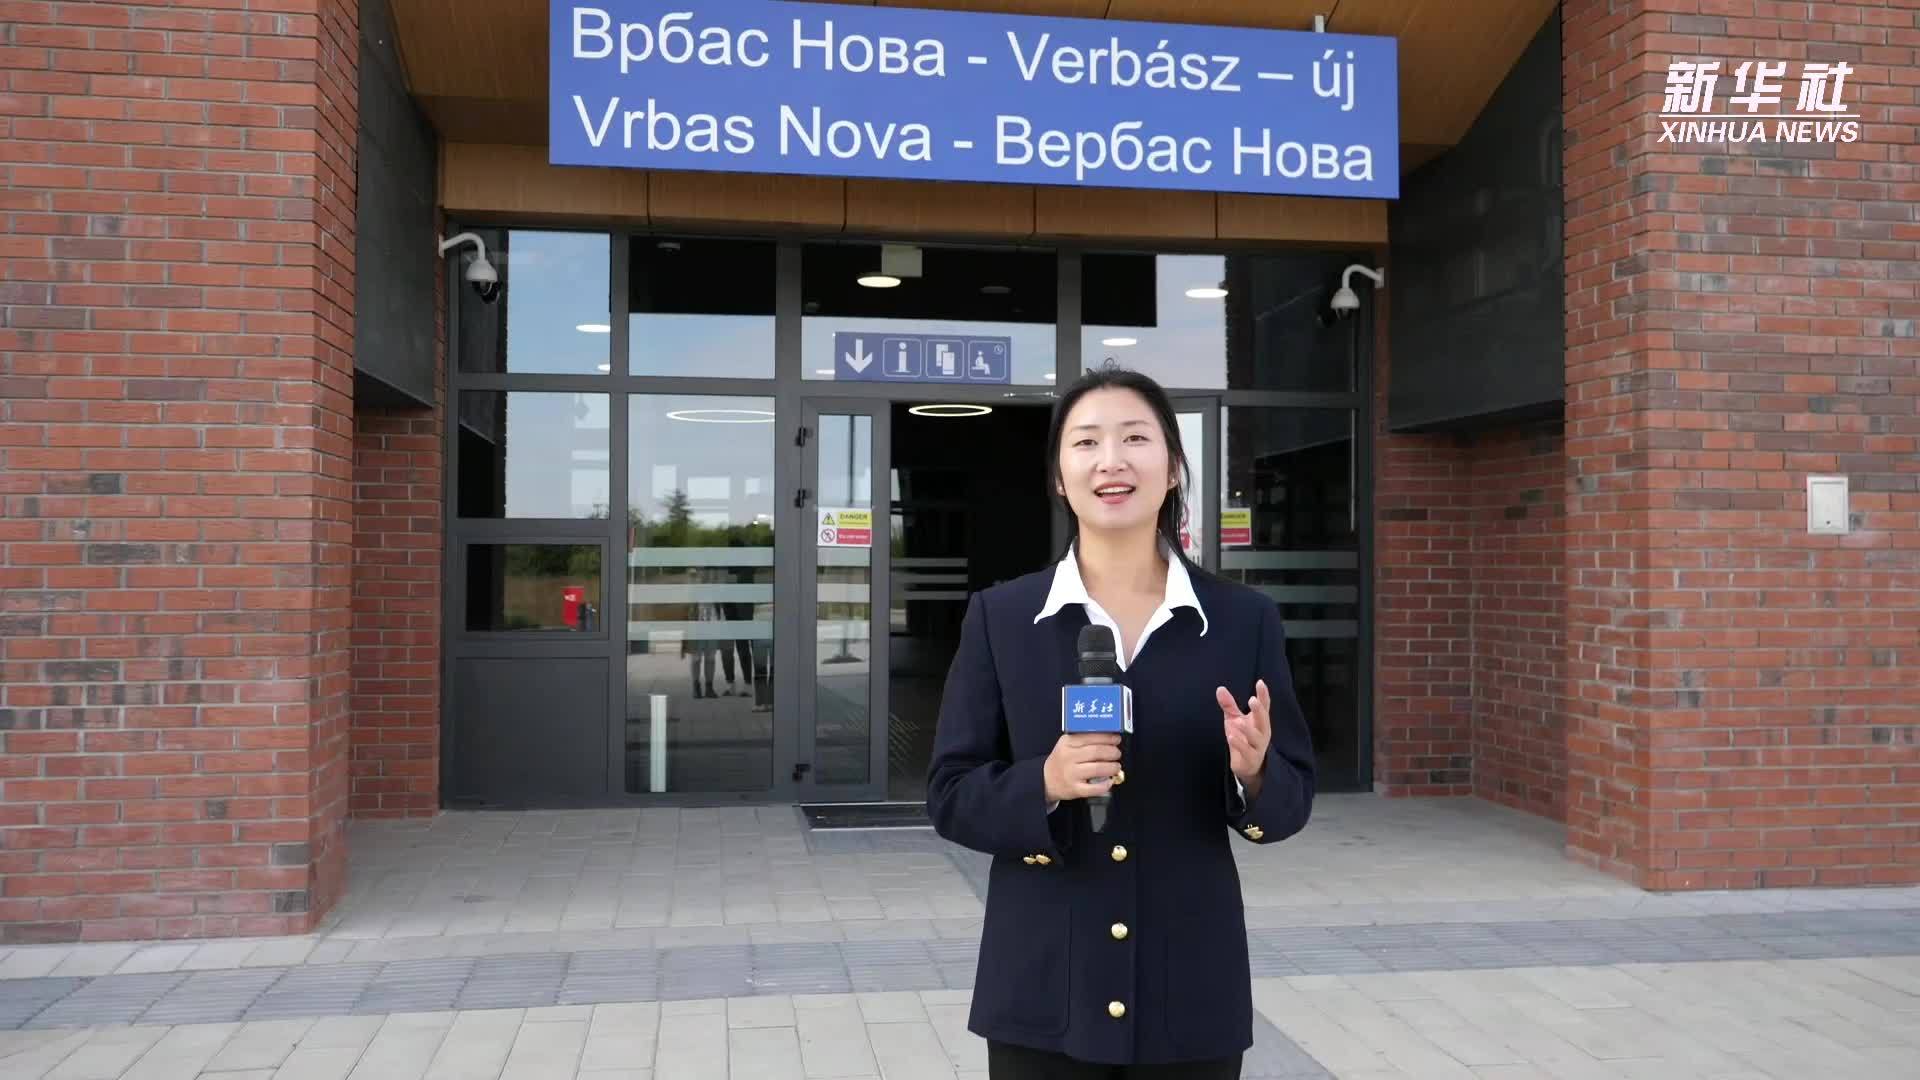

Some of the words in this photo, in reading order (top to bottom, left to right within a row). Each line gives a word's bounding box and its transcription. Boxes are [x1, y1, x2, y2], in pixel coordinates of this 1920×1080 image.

[572, 7, 769, 74] Врбас
[792, 19, 946, 77] Нова
[1007, 31, 1241, 92] Verbász
[1312, 49, 1355, 112] új
[572, 95, 755, 154] Vrbas
[779, 104, 932, 162] Nova
[996, 115, 1213, 181] Вербас
[1233, 127, 1374, 182] Нова
